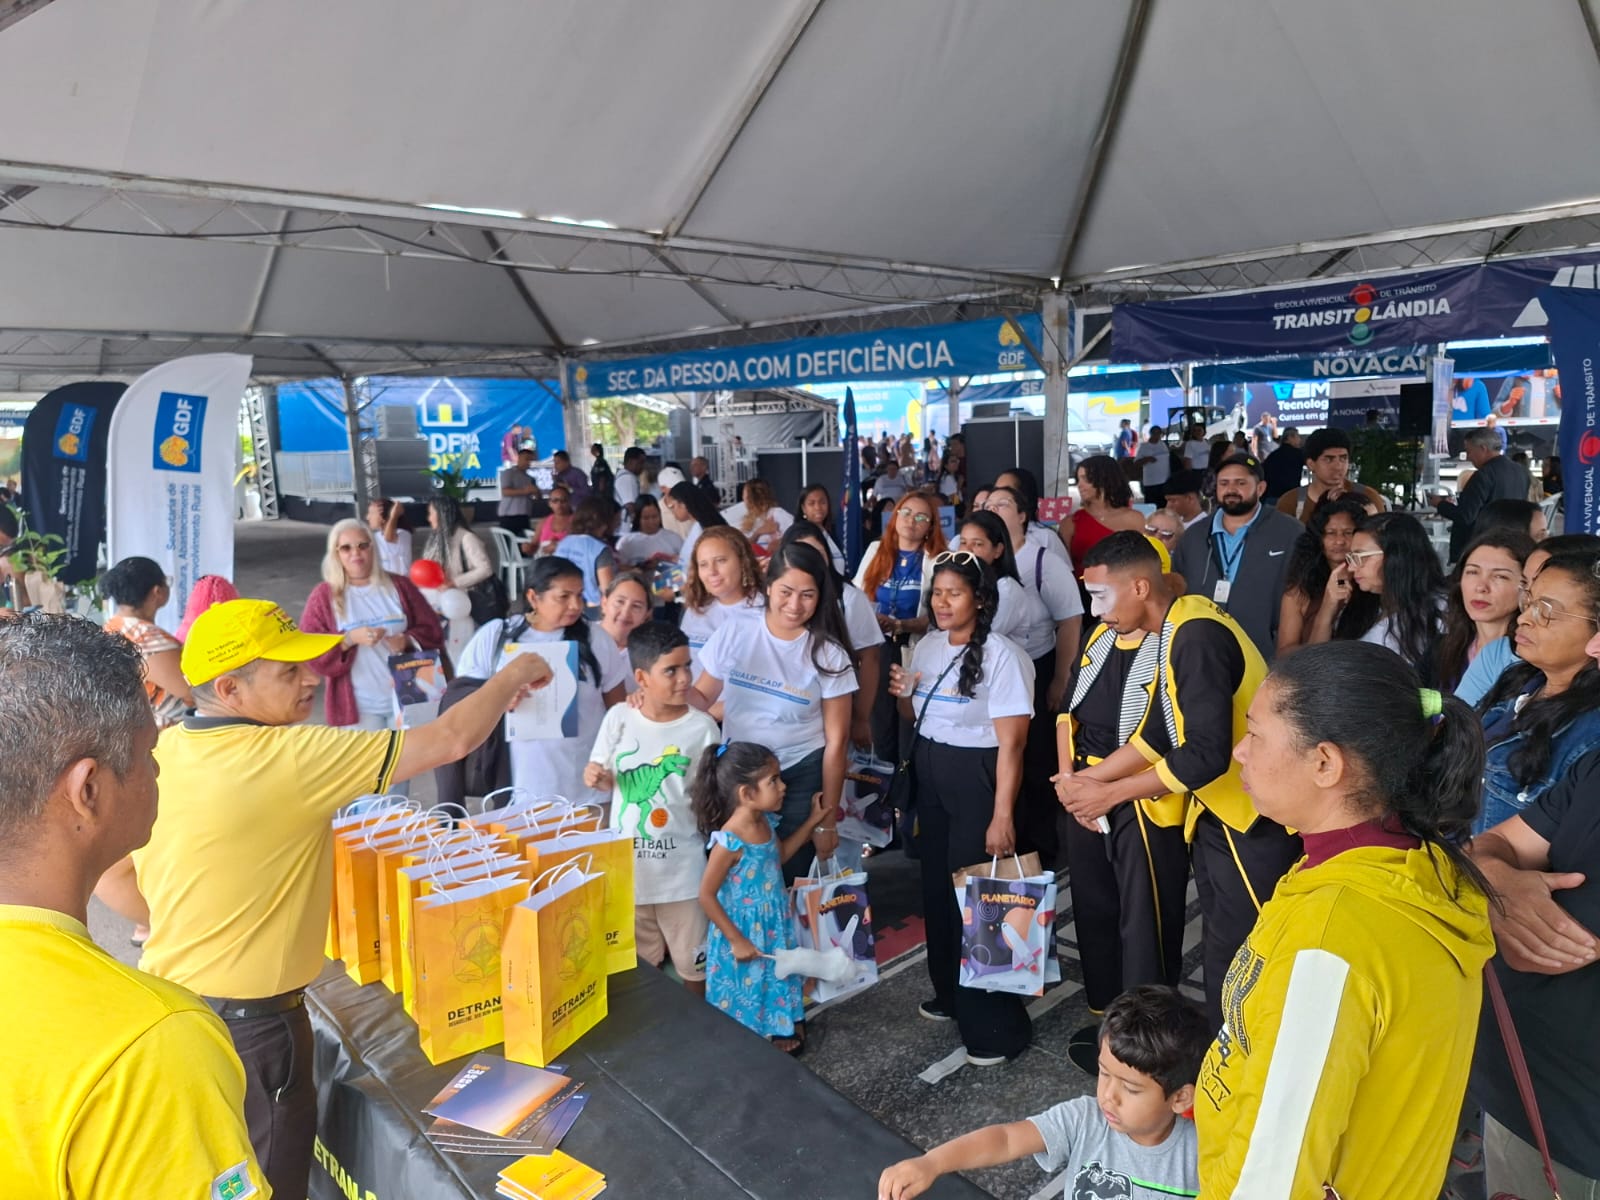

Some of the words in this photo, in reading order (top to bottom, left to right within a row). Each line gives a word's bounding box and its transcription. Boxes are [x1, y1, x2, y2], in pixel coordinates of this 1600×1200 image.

[1305, 295, 1347, 307] VIVENCIAL
[1380, 289, 1392, 298] DE
[608, 371, 640, 391] SEC.
[643, 367, 668, 388] DA
[671, 360, 741, 387] PESSOA
[744, 354, 791, 380] COM
[796, 339, 954, 378] DEFICIÊNCIA
[998, 351, 1026, 366] GDF
[69, 408, 87, 434] GDF
[173, 398, 195, 436] GDF
[1587, 412, 1595, 426] DE
[167, 483, 176, 497] de
[191, 485, 201, 511] Rural
[166, 499, 177, 550] Secretaria
[637, 850, 667, 859] ATTACK
[447, 995, 501, 1021] DETRAN
